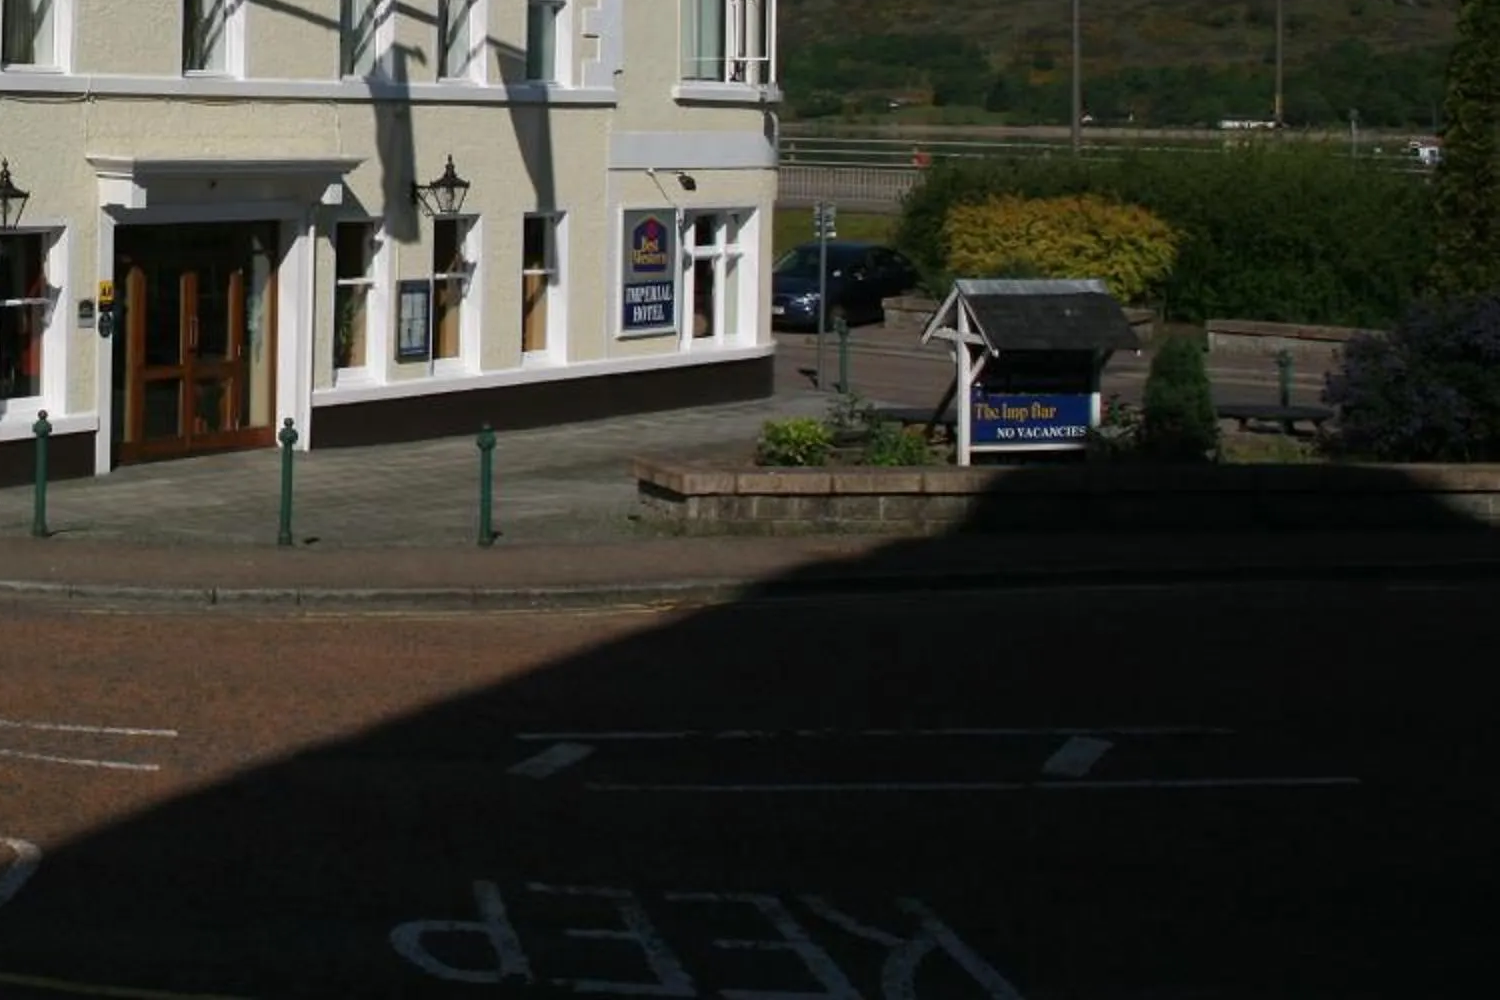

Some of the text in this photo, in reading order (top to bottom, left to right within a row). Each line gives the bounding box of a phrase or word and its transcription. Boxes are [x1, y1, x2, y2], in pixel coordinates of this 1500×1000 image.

[632, 304, 665, 323] HOTEL
[973, 403, 1000, 421] The
[996, 425, 1087, 439] NO VACANCIES
[388, 878, 1028, 1000] KEEP
